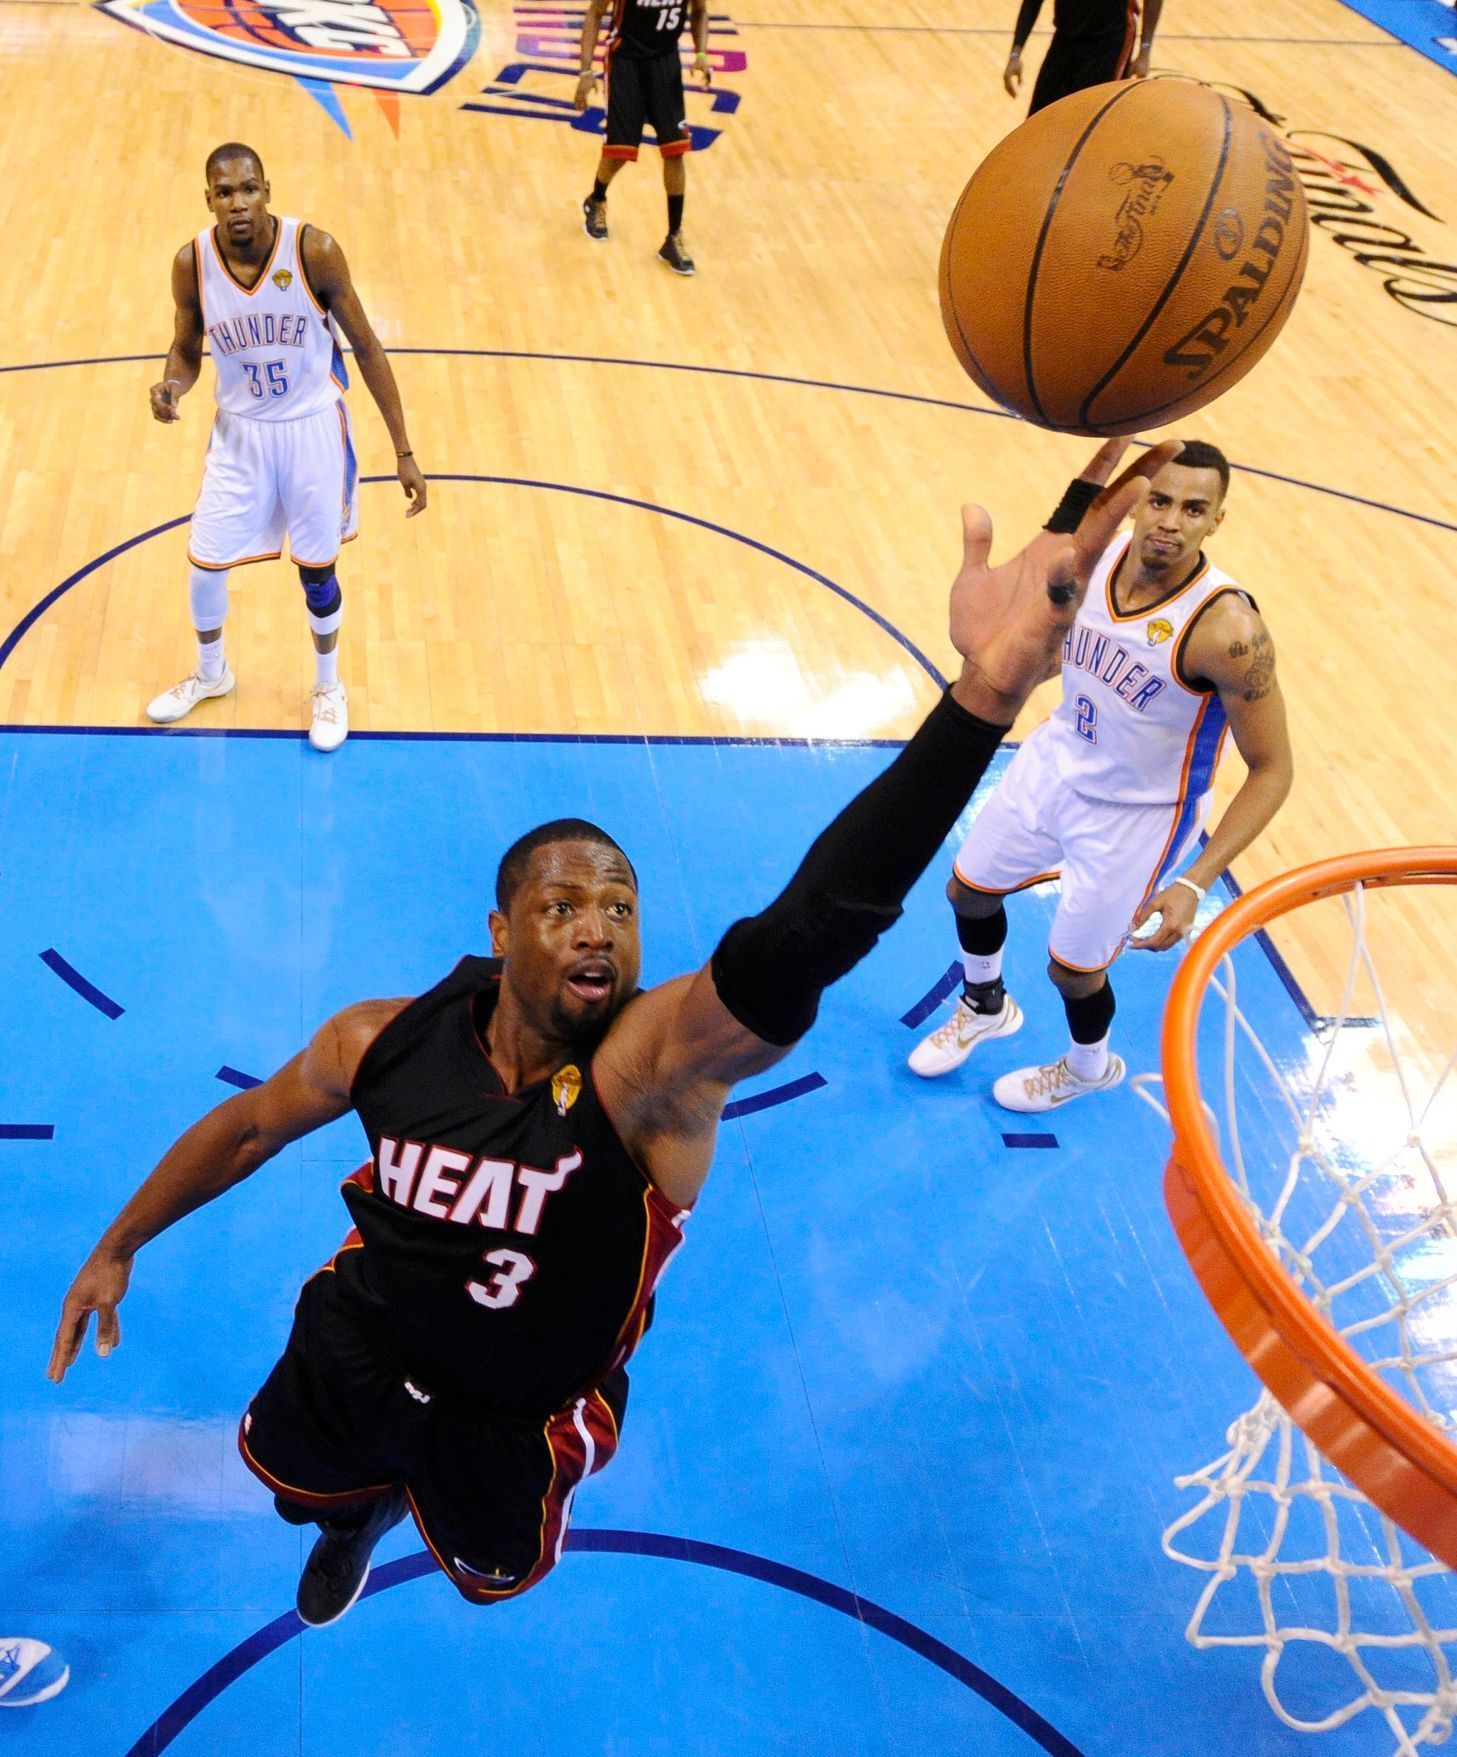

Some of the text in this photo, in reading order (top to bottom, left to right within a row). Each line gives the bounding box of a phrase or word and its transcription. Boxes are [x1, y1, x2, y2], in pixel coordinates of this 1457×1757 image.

[656, 7, 682, 31] 15
[1164, 131, 1296, 381] SPALDING
[207, 313, 309, 357] THUNDER
[240, 358, 290, 400] 35
[1061, 624, 1167, 712] HUNDER
[1075, 694, 1097, 745] 2
[378, 1136, 584, 1236] HEAT
[467, 1248, 536, 1309] 3
